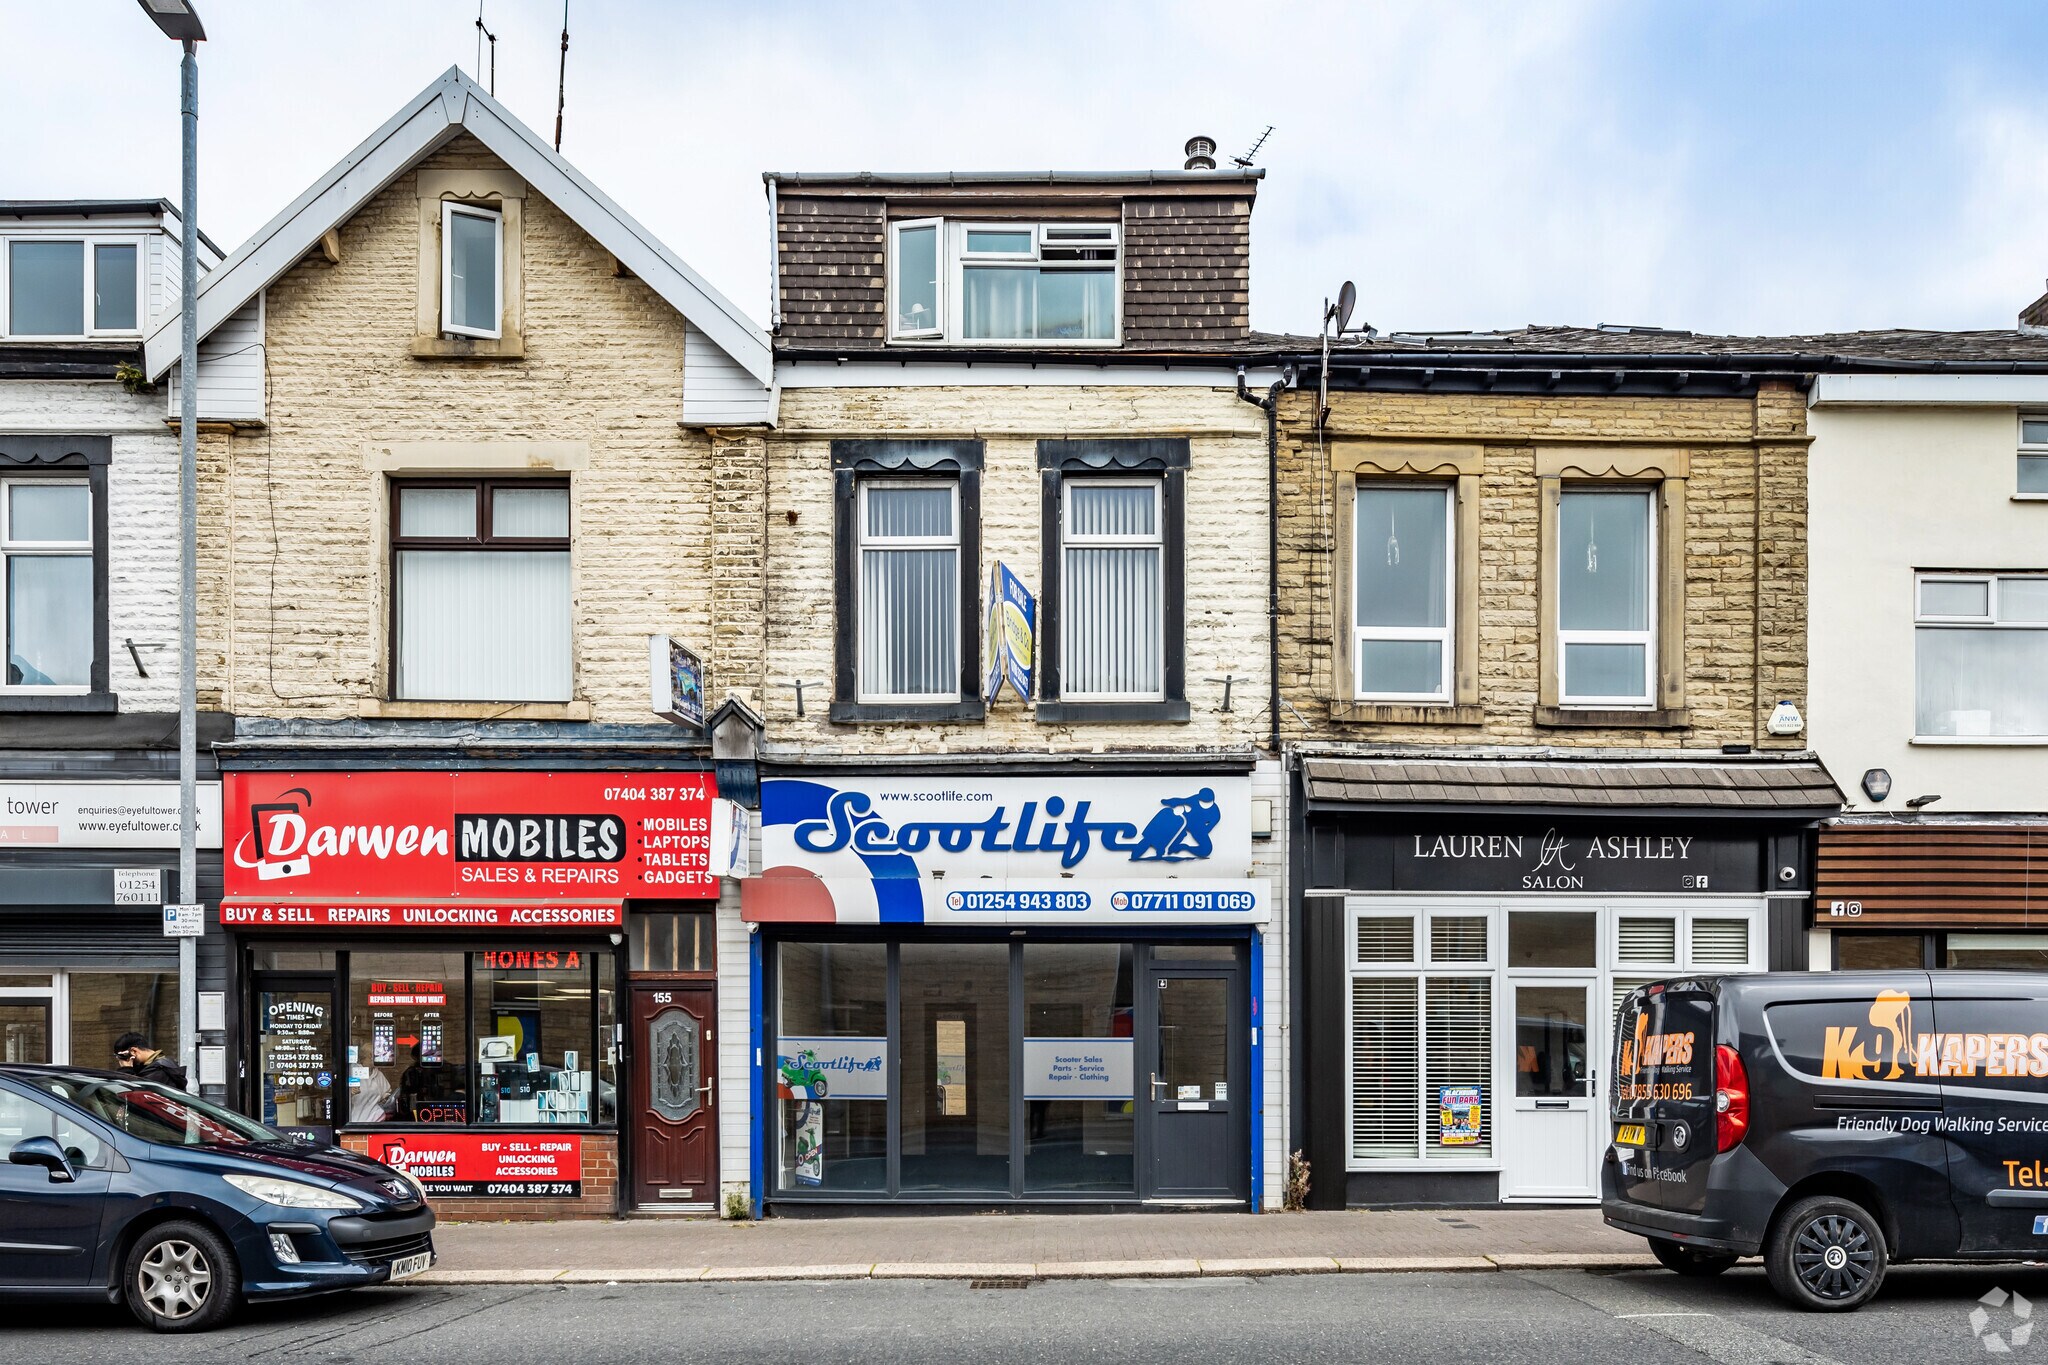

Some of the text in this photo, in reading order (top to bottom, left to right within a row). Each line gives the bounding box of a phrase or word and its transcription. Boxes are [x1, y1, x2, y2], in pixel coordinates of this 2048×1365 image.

[604, 787, 705, 800] 07404 387 374
[880, 790, 993, 803] www.scootlife.com
[7, 797, 59, 814] tower
[78, 806, 201, 817] enquiries@eyefultower.ck
[78, 821, 201, 834] www.eyefultower.ck
[643, 818, 707, 832] MOBILES
[268, 813, 449, 858] Darwen
[461, 818, 619, 861] MOBILES
[643, 836, 710, 849] LAPTOPS
[1414, 834, 1523, 859] LAUREN
[1586, 836, 1694, 860] ASHLEY
[643, 853, 708, 866] TABLETS
[461, 867, 619, 884] SALES & REPAIRS
[643, 871, 713, 884] GADGETS
[1522, 875, 1584, 889] SALON
[119, 880, 156, 890] 01254
[116, 892, 159, 902] 760111
[949, 893, 1088, 910] Tel 01254 943 803
[1112, 894, 1252, 910] Mob 07711 091 069
[225, 907, 616, 923] BUY & SELL REPAIRS UNLOCKING ACCESSORIES
[371, 983, 387, 992] BUY
[393, 983, 410, 992] SELL
[415, 983, 443, 992] REPAIR
[652, 992, 672, 1003] 155
[268, 1002, 324, 1017] OPENING
[1915, 1032, 2048, 1078] KAPERS
[1048, 1073, 1072, 1082] Repair
[1079, 1073, 1109, 1082] Clothing
[1653, 1083, 1671, 1100] 630
[1672, 1083, 1692, 1100] 696
[1442, 1096, 1457, 1104] FUN
[419, 1108, 466, 1123] OPEN
[1837, 1116, 2048, 1134] Friendly Dog Walking Service
[481, 1143, 501, 1152] BUY
[509, 1143, 532, 1152] SELL
[539, 1143, 572, 1152] REPAIR
[390, 1147, 457, 1164] Darwen
[498, 1155, 555, 1164] UNLOCKING
[410, 1166, 455, 1177] MOBILES
[495, 1167, 558, 1176] ACCESSORIES
[487, 1184, 573, 1194] 07404 387 374
